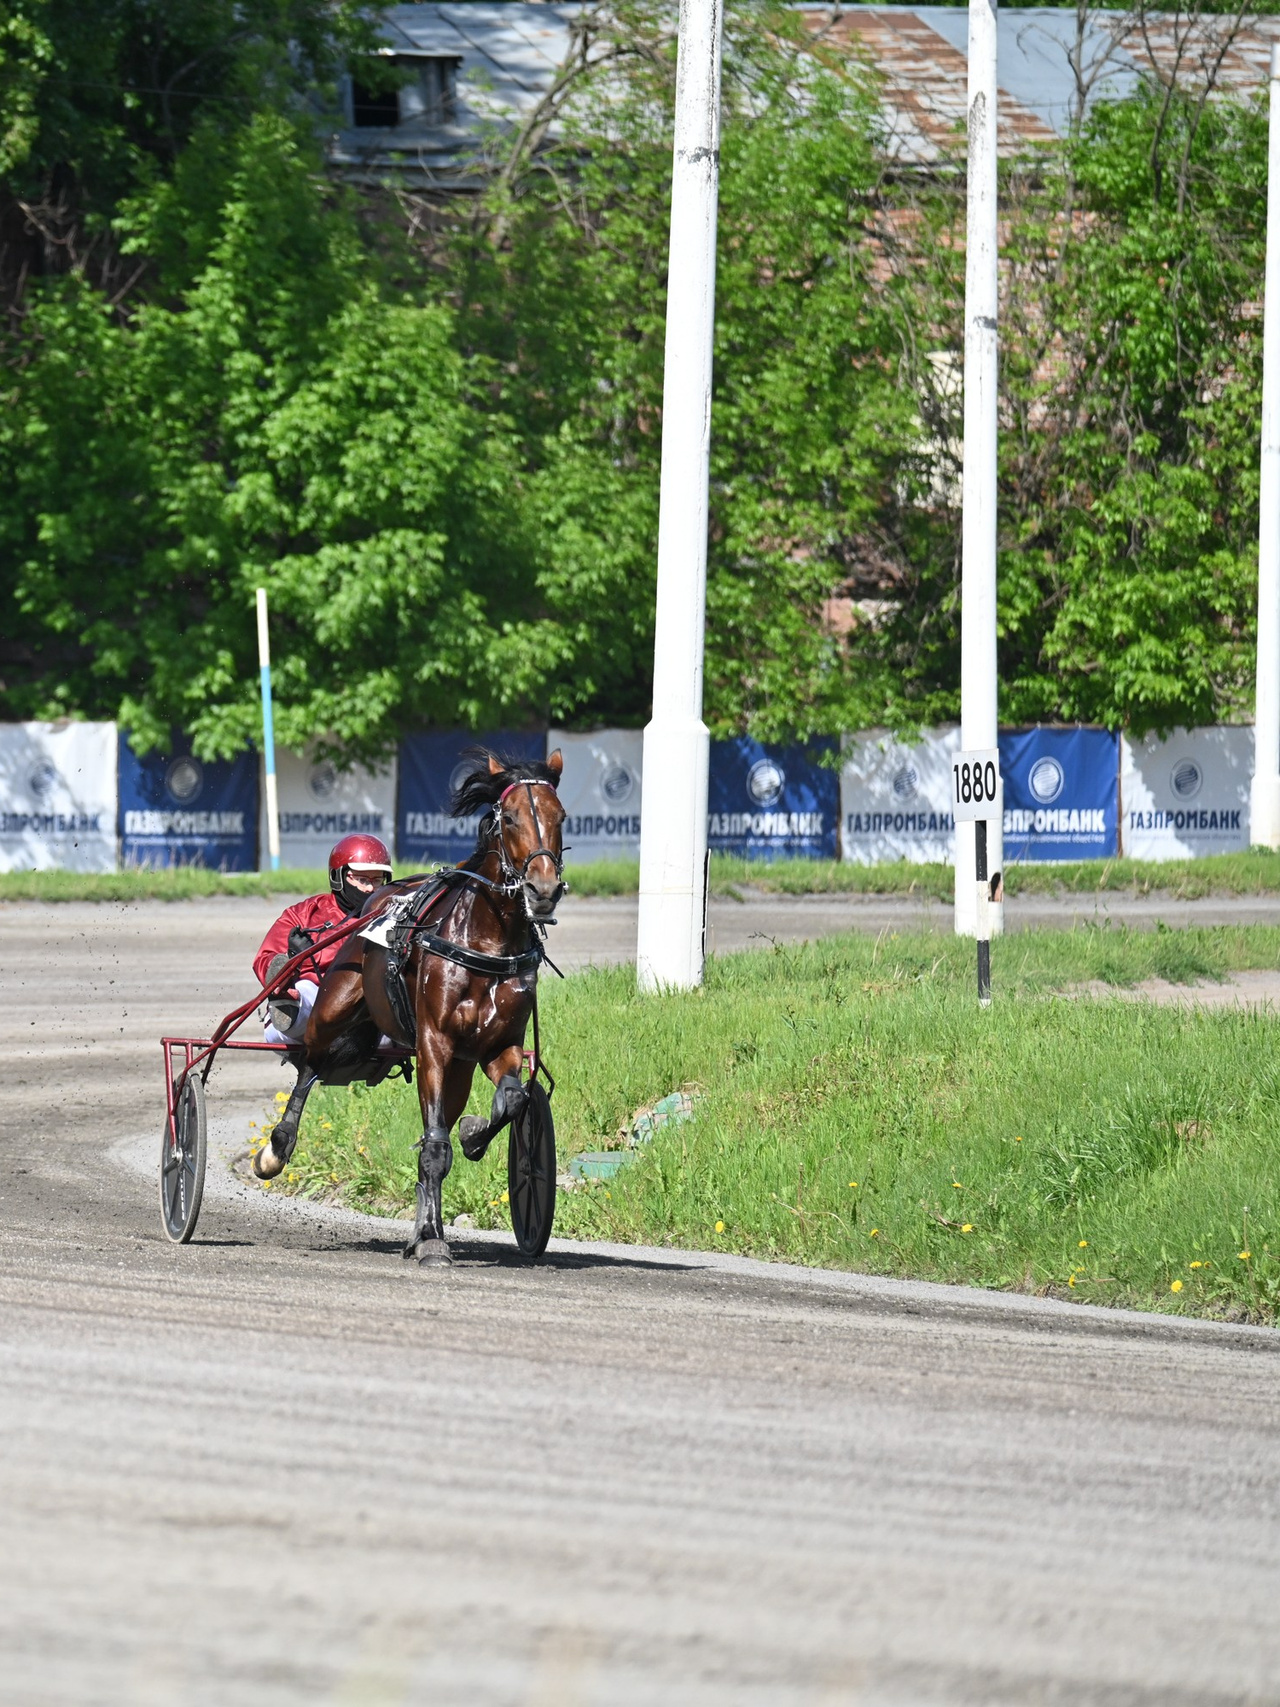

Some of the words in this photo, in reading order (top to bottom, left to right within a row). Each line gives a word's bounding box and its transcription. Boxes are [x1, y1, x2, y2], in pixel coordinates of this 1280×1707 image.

[953, 760, 996, 803] 1880
[124, 810, 244, 834] ГАЗПРОМБАНК
[278, 812, 383, 833] ЗПРОМБАНК
[405, 812, 480, 836] ГАЗПРОМ
[564, 815, 640, 836] АЗПРОМБ
[1002, 809, 1106, 833] ЗПРОМБАНК
[1130, 809, 1241, 830] ГАЗПРОМБАНК
